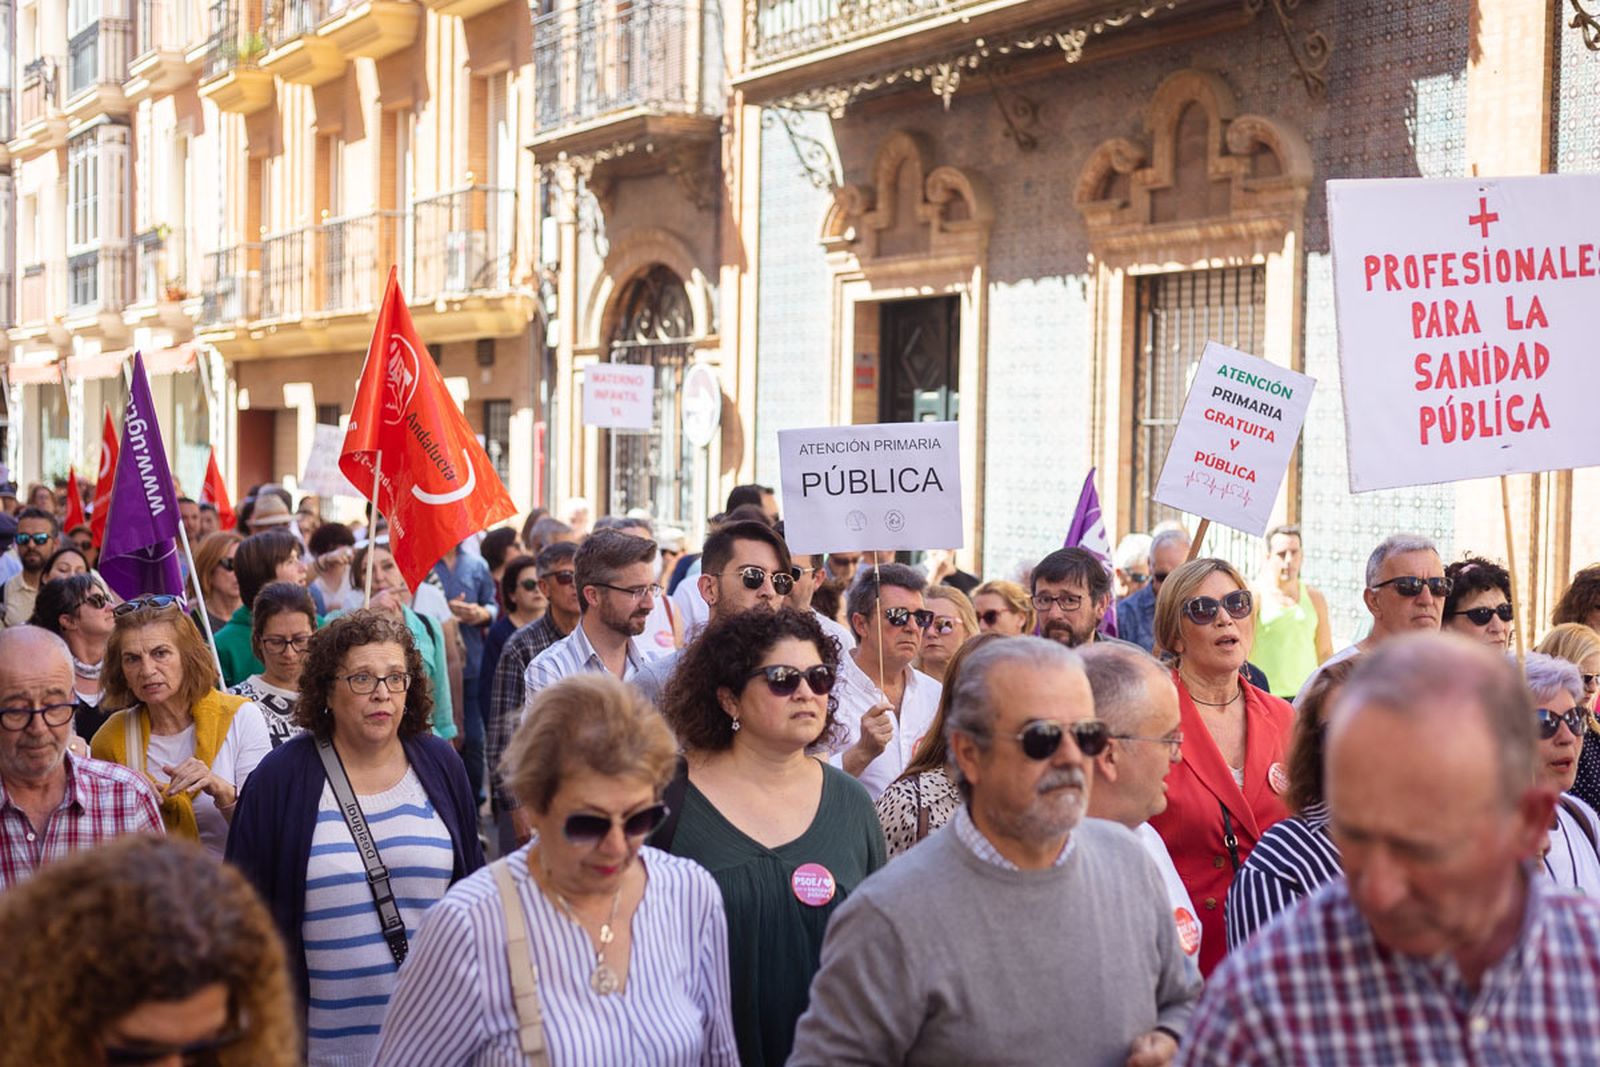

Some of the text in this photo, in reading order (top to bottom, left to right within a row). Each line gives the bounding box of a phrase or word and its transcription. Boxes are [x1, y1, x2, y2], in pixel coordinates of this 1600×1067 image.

[1411, 295, 1549, 339] PARA LA
[1216, 364, 1293, 400] ATENCIÓN
[1211, 386, 1283, 421] PRIMARIA
[1204, 408, 1275, 443] GRATUITA
[406, 412, 457, 482] Andalucía
[800, 438, 942, 456] ATENCIÓN PRIMARIA
[1230, 438, 1240, 451] Y
[802, 465, 944, 498] PÚBLICA
[1193, 450, 1256, 483] PÚBLICA
